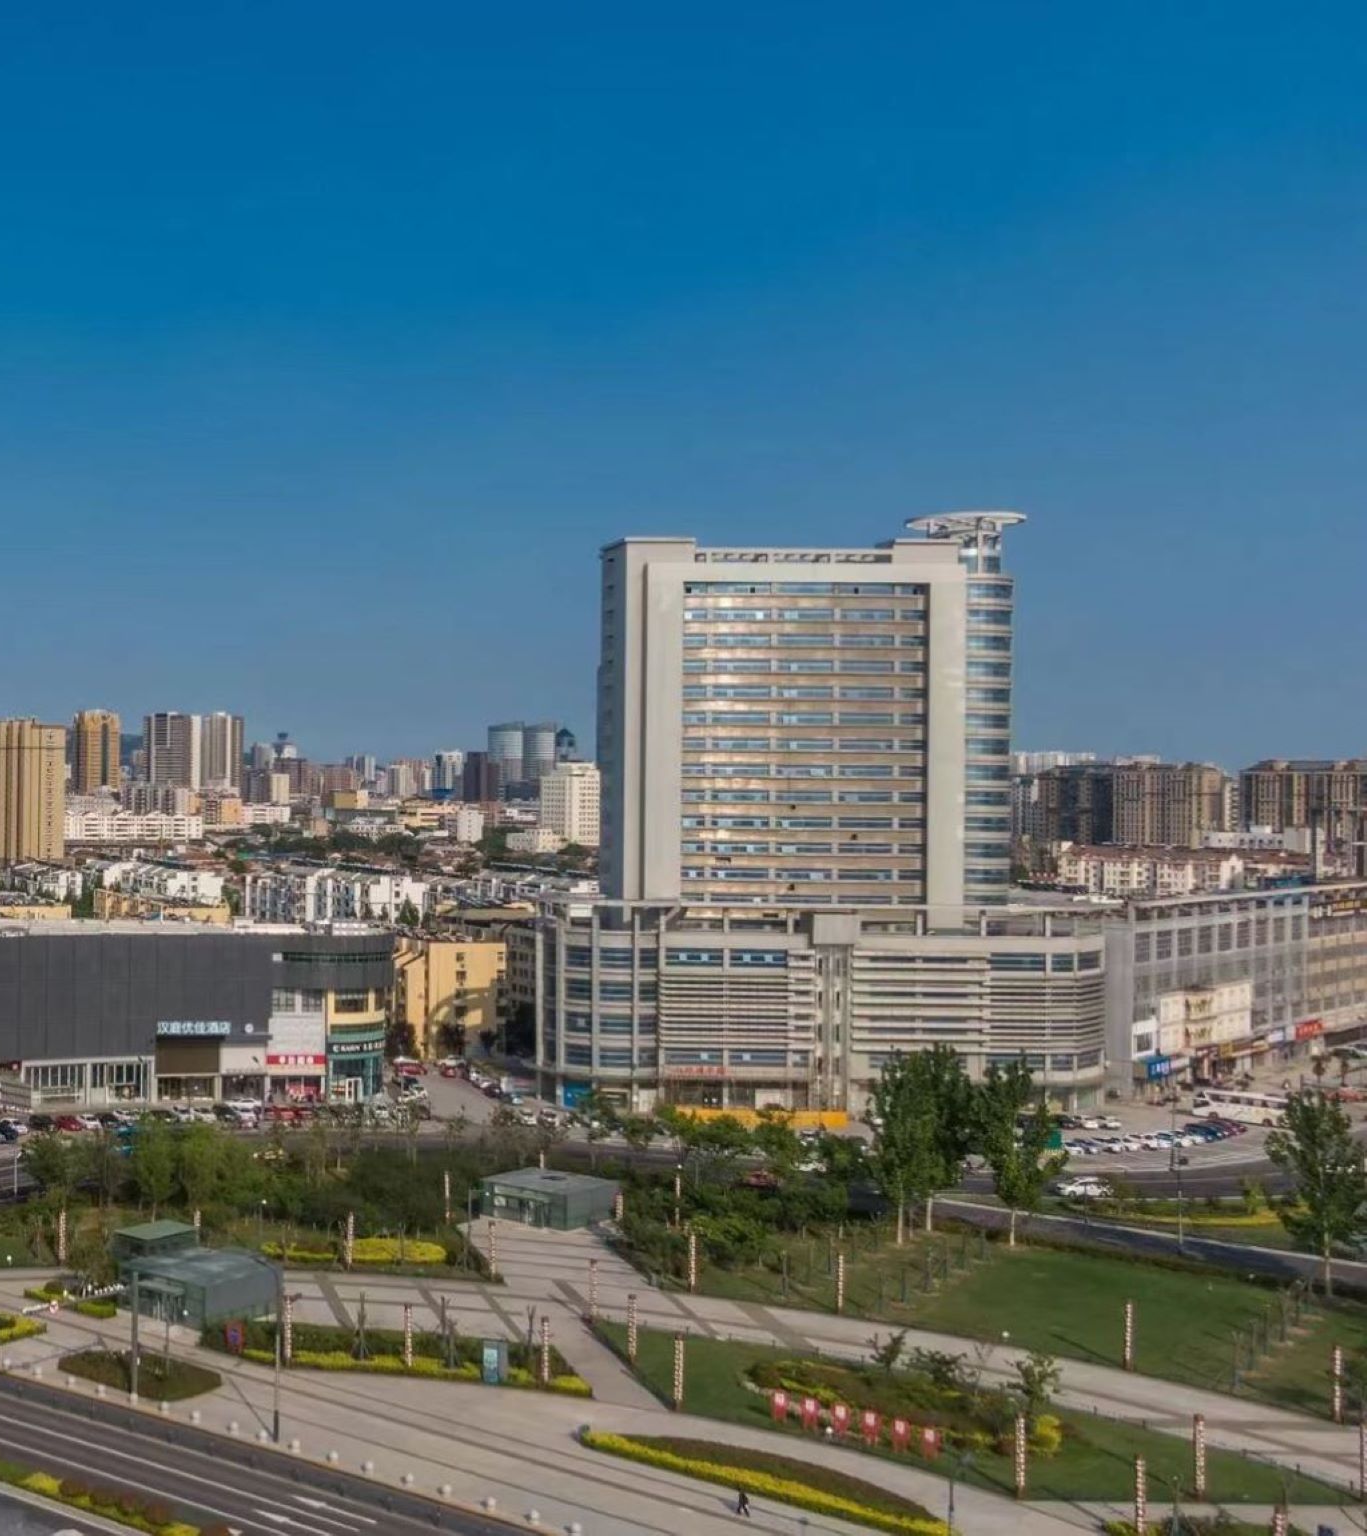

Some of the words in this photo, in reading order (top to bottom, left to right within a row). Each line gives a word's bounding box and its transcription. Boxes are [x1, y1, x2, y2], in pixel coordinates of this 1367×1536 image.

[157, 1020, 231, 1035] 汉庭优佳酒店
